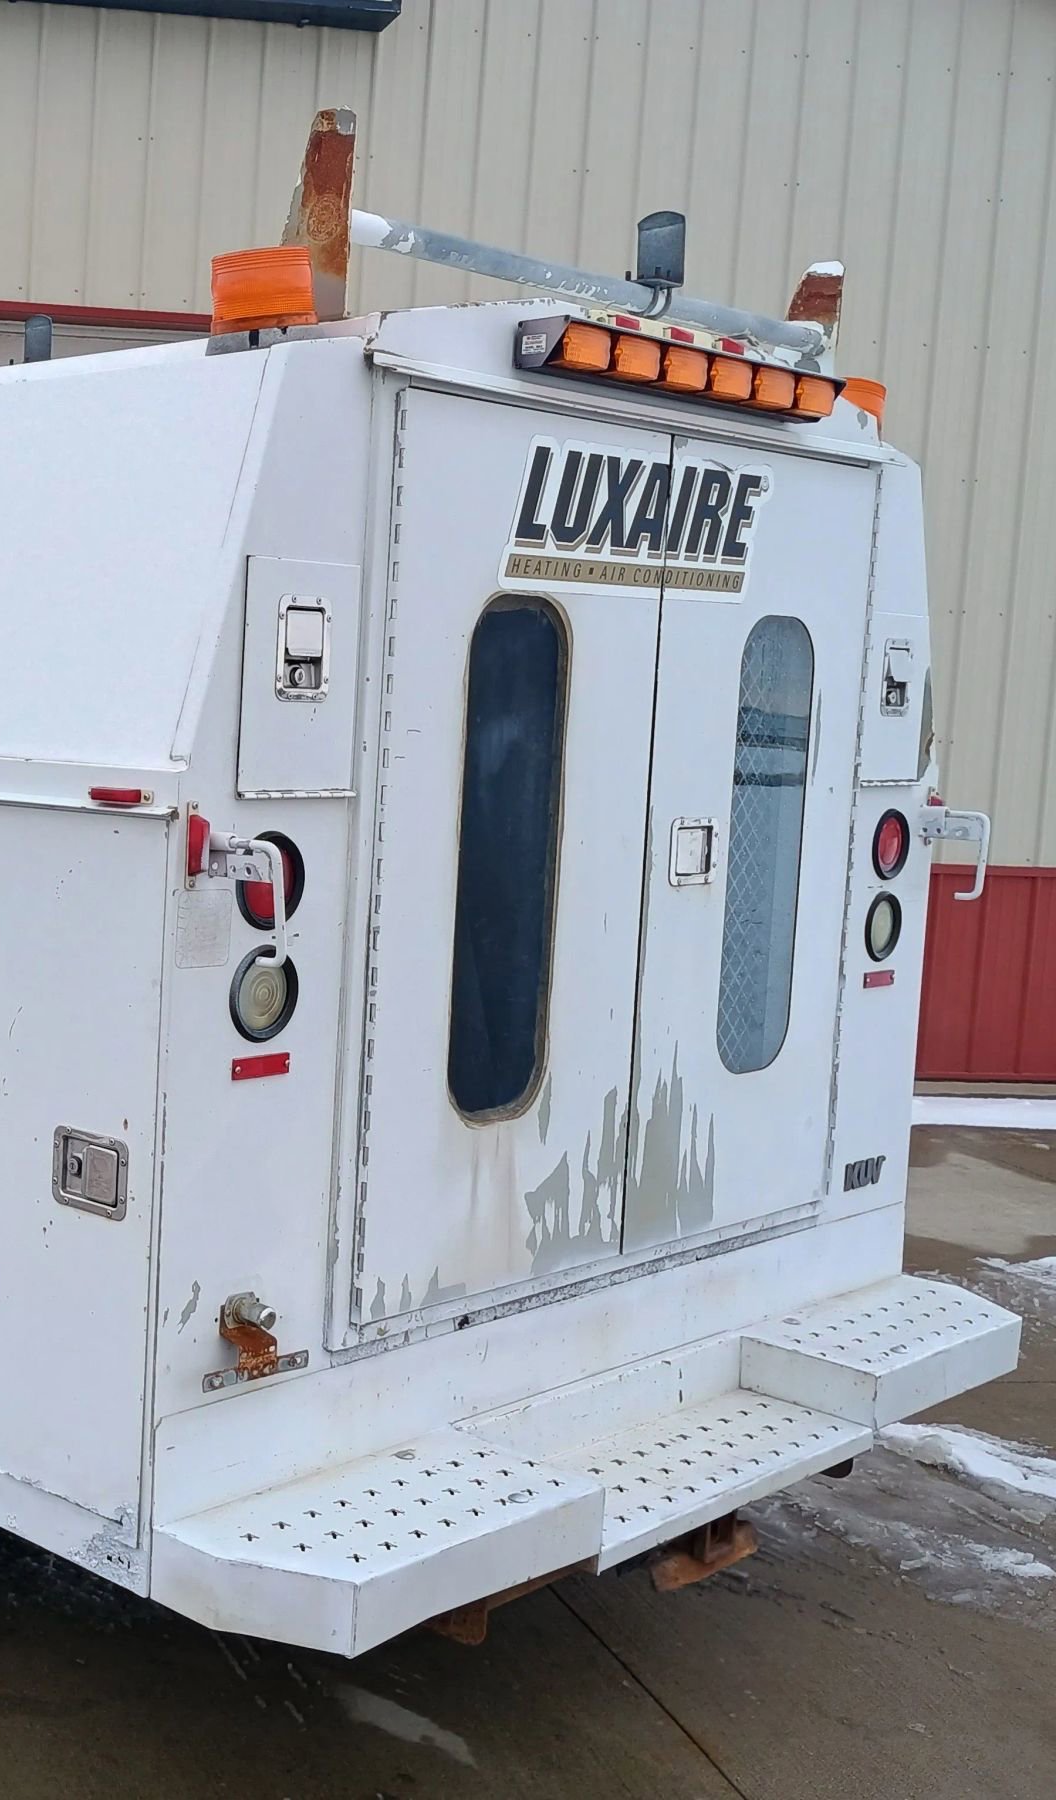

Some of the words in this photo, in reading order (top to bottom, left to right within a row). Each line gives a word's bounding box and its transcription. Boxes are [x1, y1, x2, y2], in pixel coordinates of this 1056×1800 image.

[514, 445, 762, 564] LUXAIRE
[510, 556, 583, 580] HEATING
[599, 565, 626, 583] AIR
[632, 567, 741, 590] CONDITIONING
